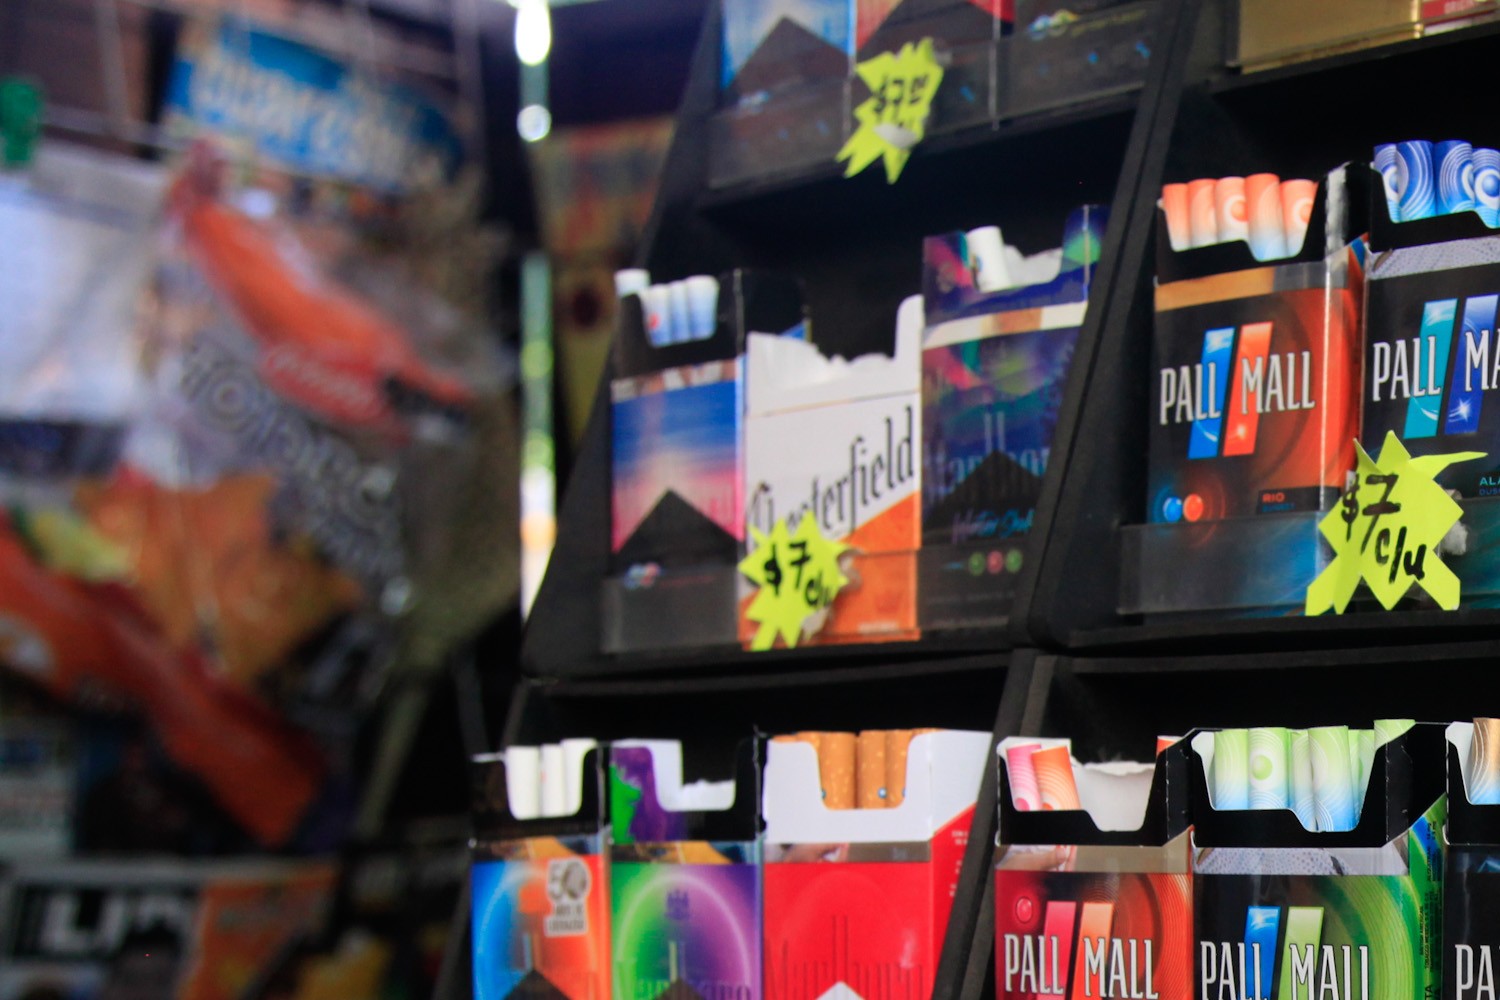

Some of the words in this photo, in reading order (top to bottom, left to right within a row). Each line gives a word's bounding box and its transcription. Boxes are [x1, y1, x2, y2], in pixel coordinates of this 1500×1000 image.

[1160, 362, 1221, 425] PALL
[1241, 352, 1315, 415] MALL
[1373, 336, 1441, 401] PALL
[1262, 492, 1285, 503] RIO
[1341, 472, 1402, 556] $7
[1375, 526, 1427, 584] c/u
[1004, 934, 1064, 995] PALL
[1083, 937, 1159, 1000] MALL
